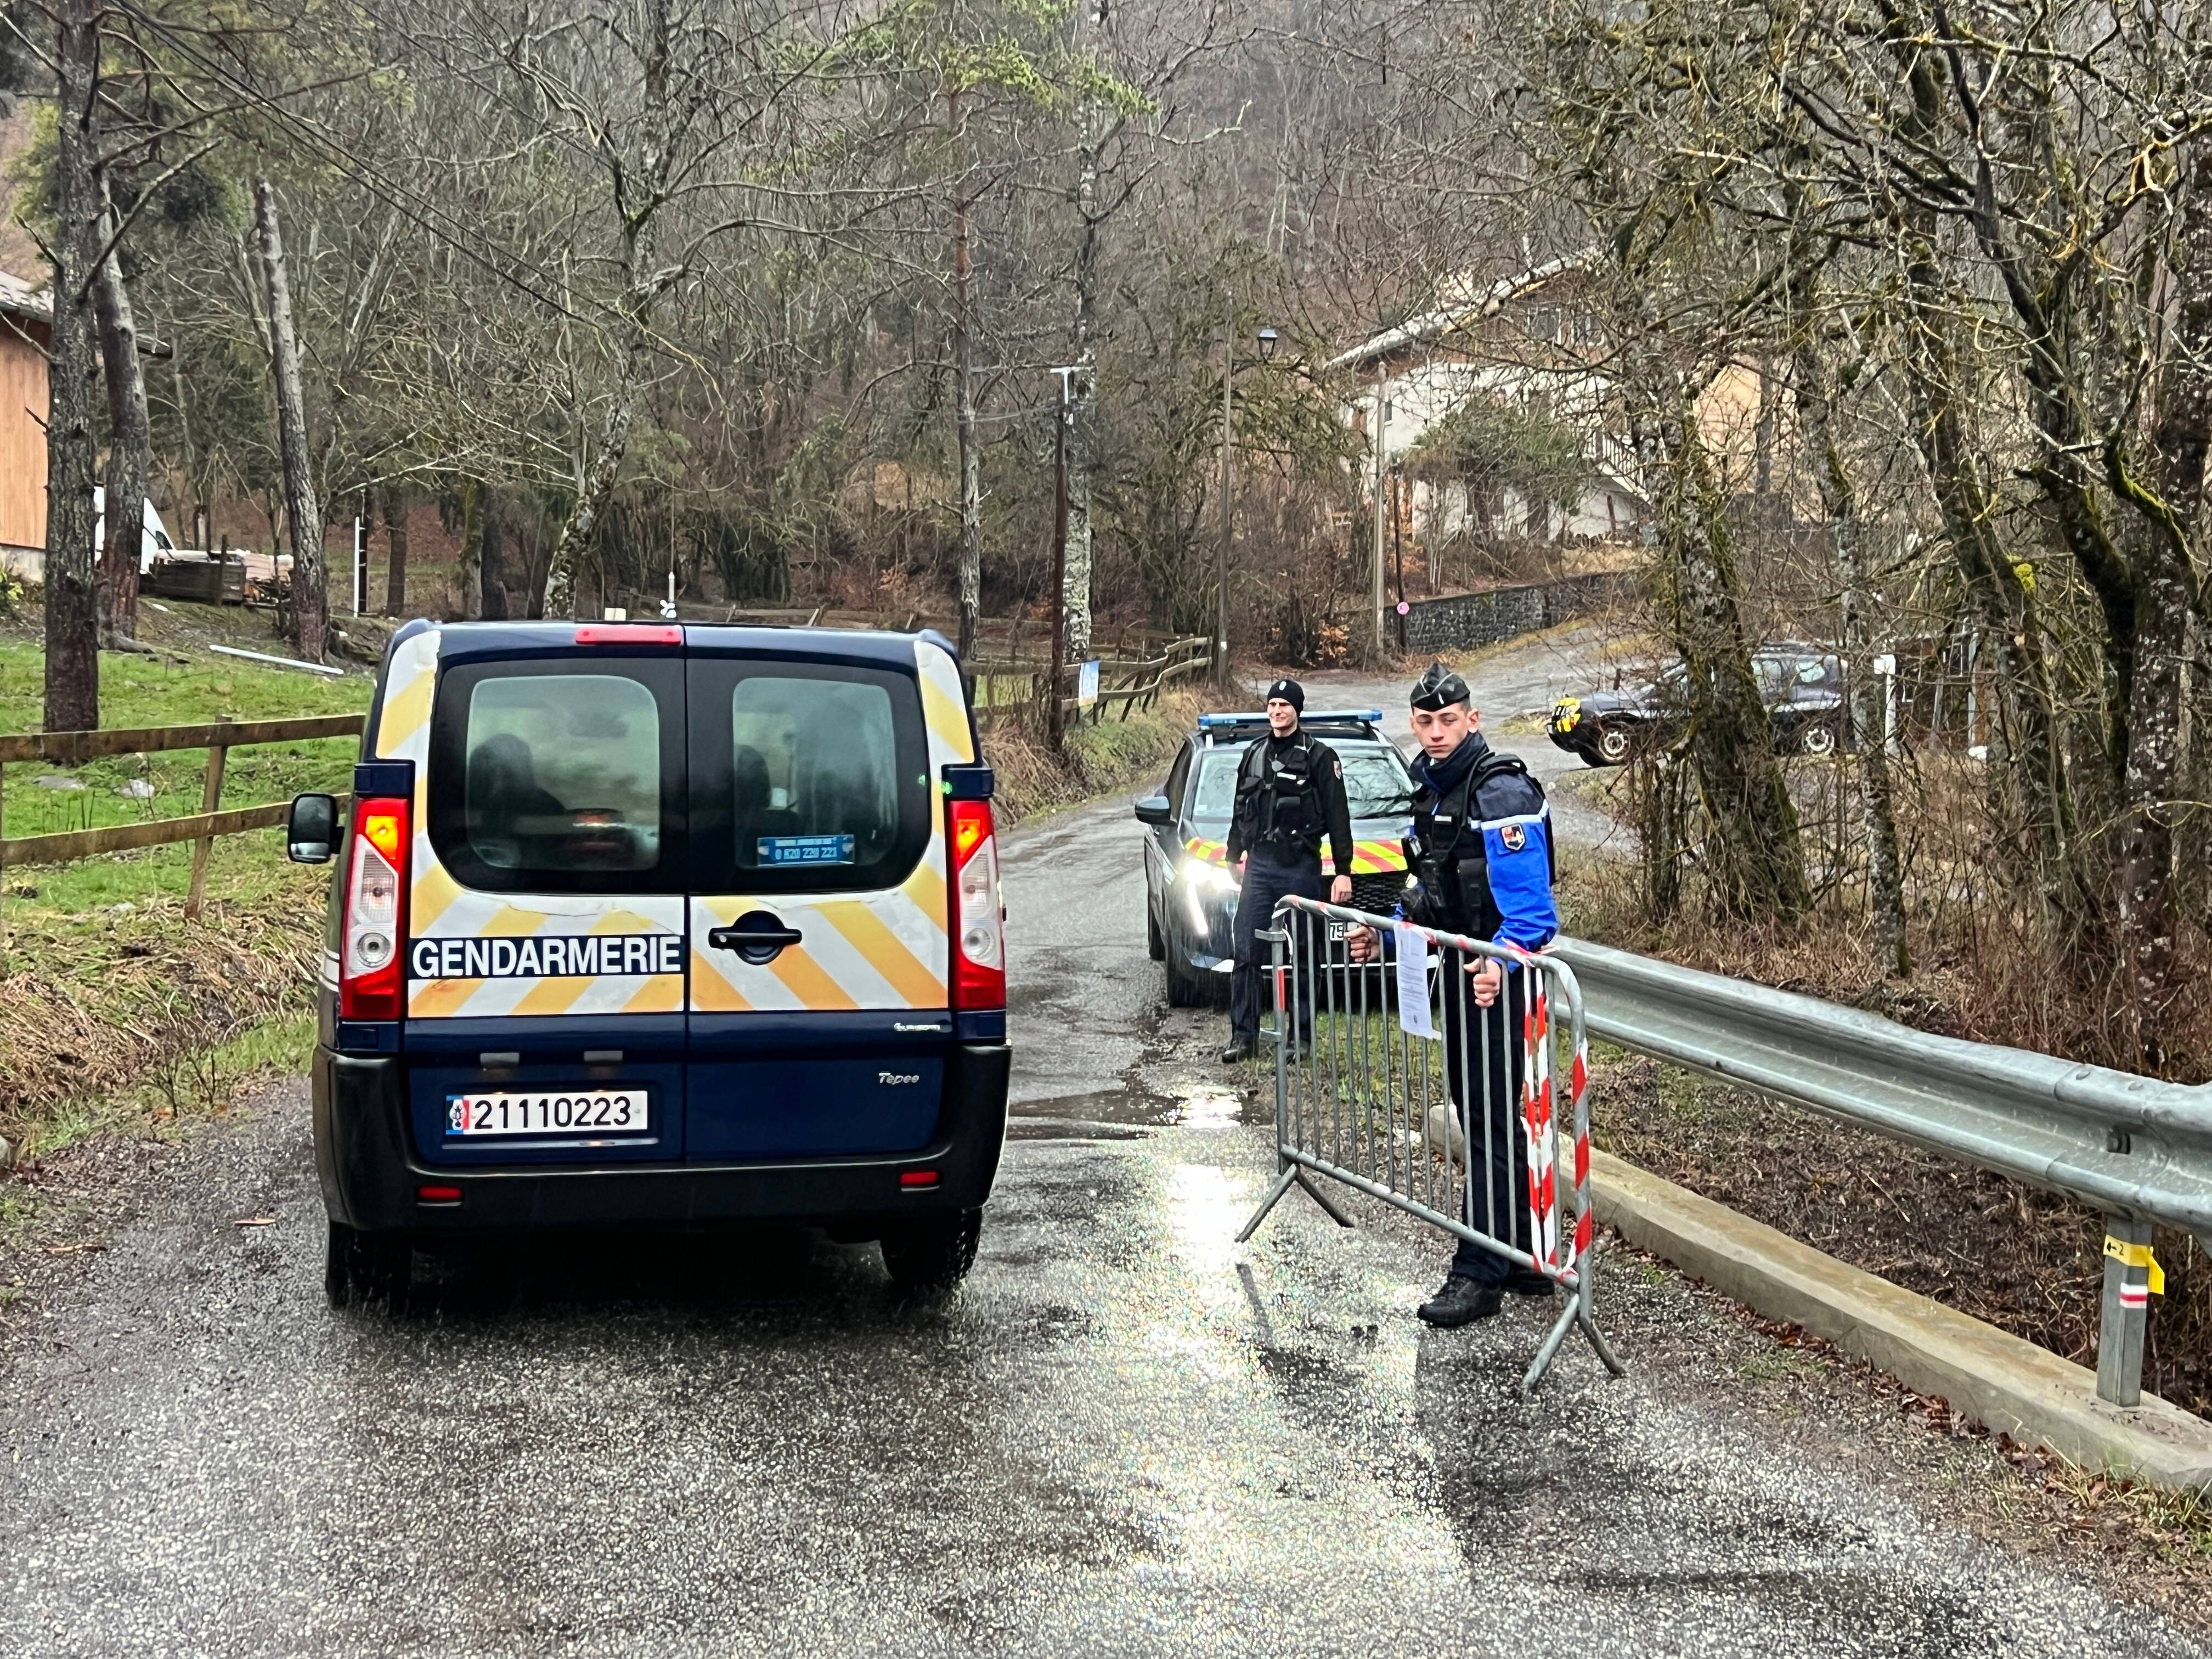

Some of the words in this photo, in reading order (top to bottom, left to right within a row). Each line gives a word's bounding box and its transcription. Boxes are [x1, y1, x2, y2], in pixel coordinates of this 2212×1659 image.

[413, 937, 681, 977] GENDARMERIE
[879, 1073, 919, 1085] Tepee
[474, 1096, 631, 1129] 21110223
